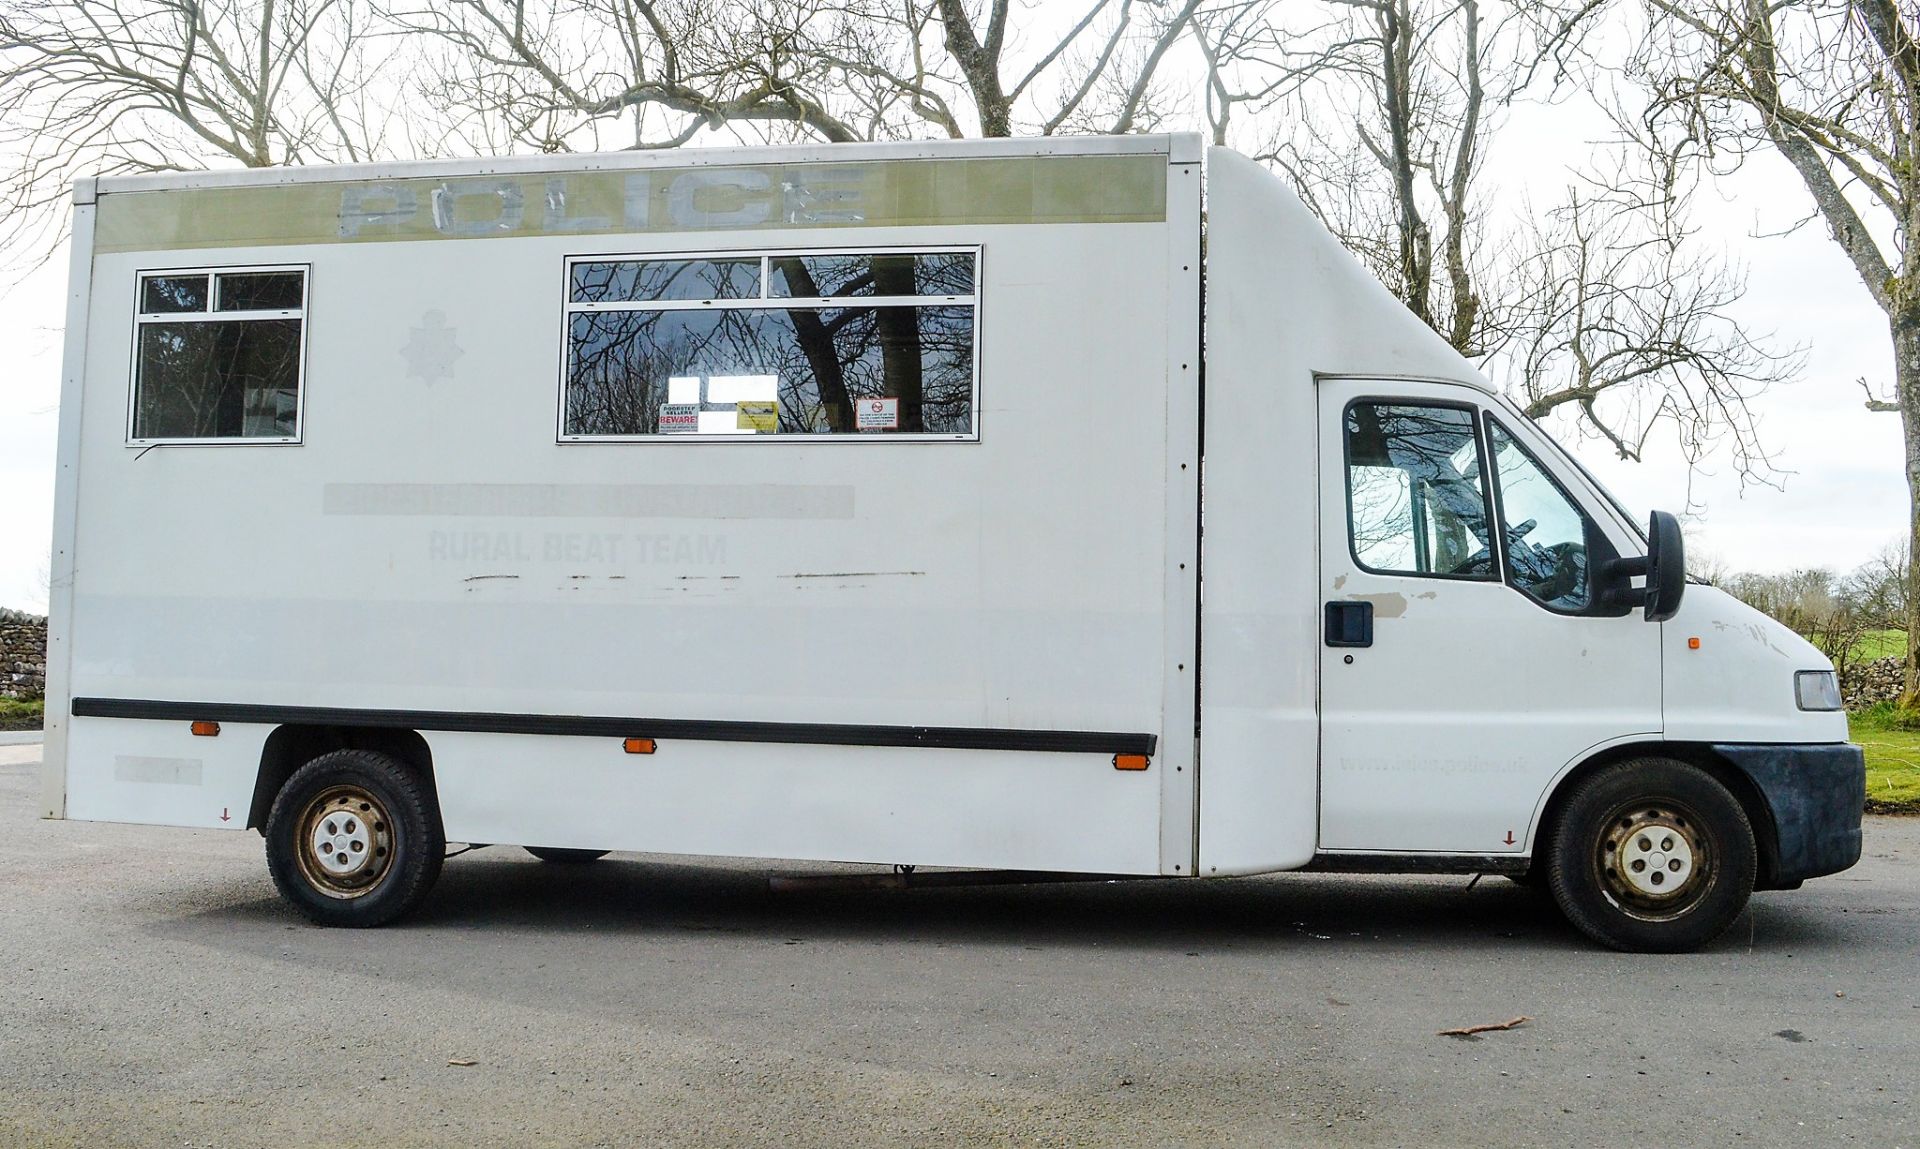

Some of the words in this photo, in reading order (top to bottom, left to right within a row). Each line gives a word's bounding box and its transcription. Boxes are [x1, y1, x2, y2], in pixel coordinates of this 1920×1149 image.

[337, 168, 866, 238] POLICE
[429, 530, 530, 562] RURAL
[542, 532, 623, 563] BEAT
[635, 533, 728, 565] TEAM
